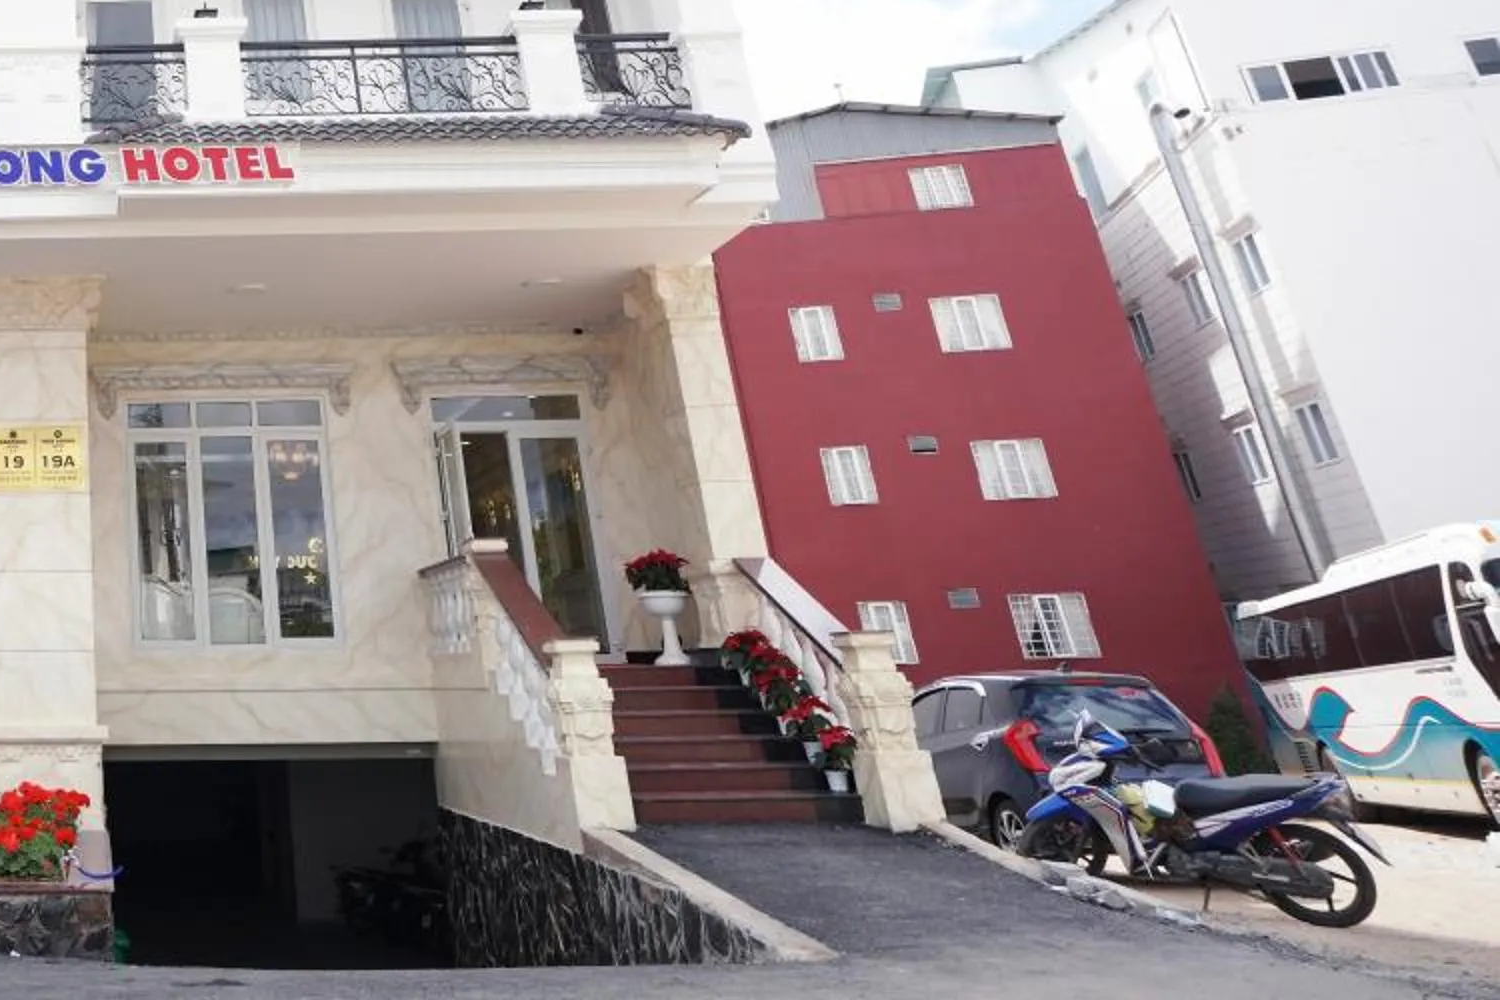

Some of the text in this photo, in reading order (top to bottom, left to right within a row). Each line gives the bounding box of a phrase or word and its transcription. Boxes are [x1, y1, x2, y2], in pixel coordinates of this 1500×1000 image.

[121, 146, 296, 182] HOTEL
[3, 455, 25, 469] 19
[42, 455, 76, 468] 19A
